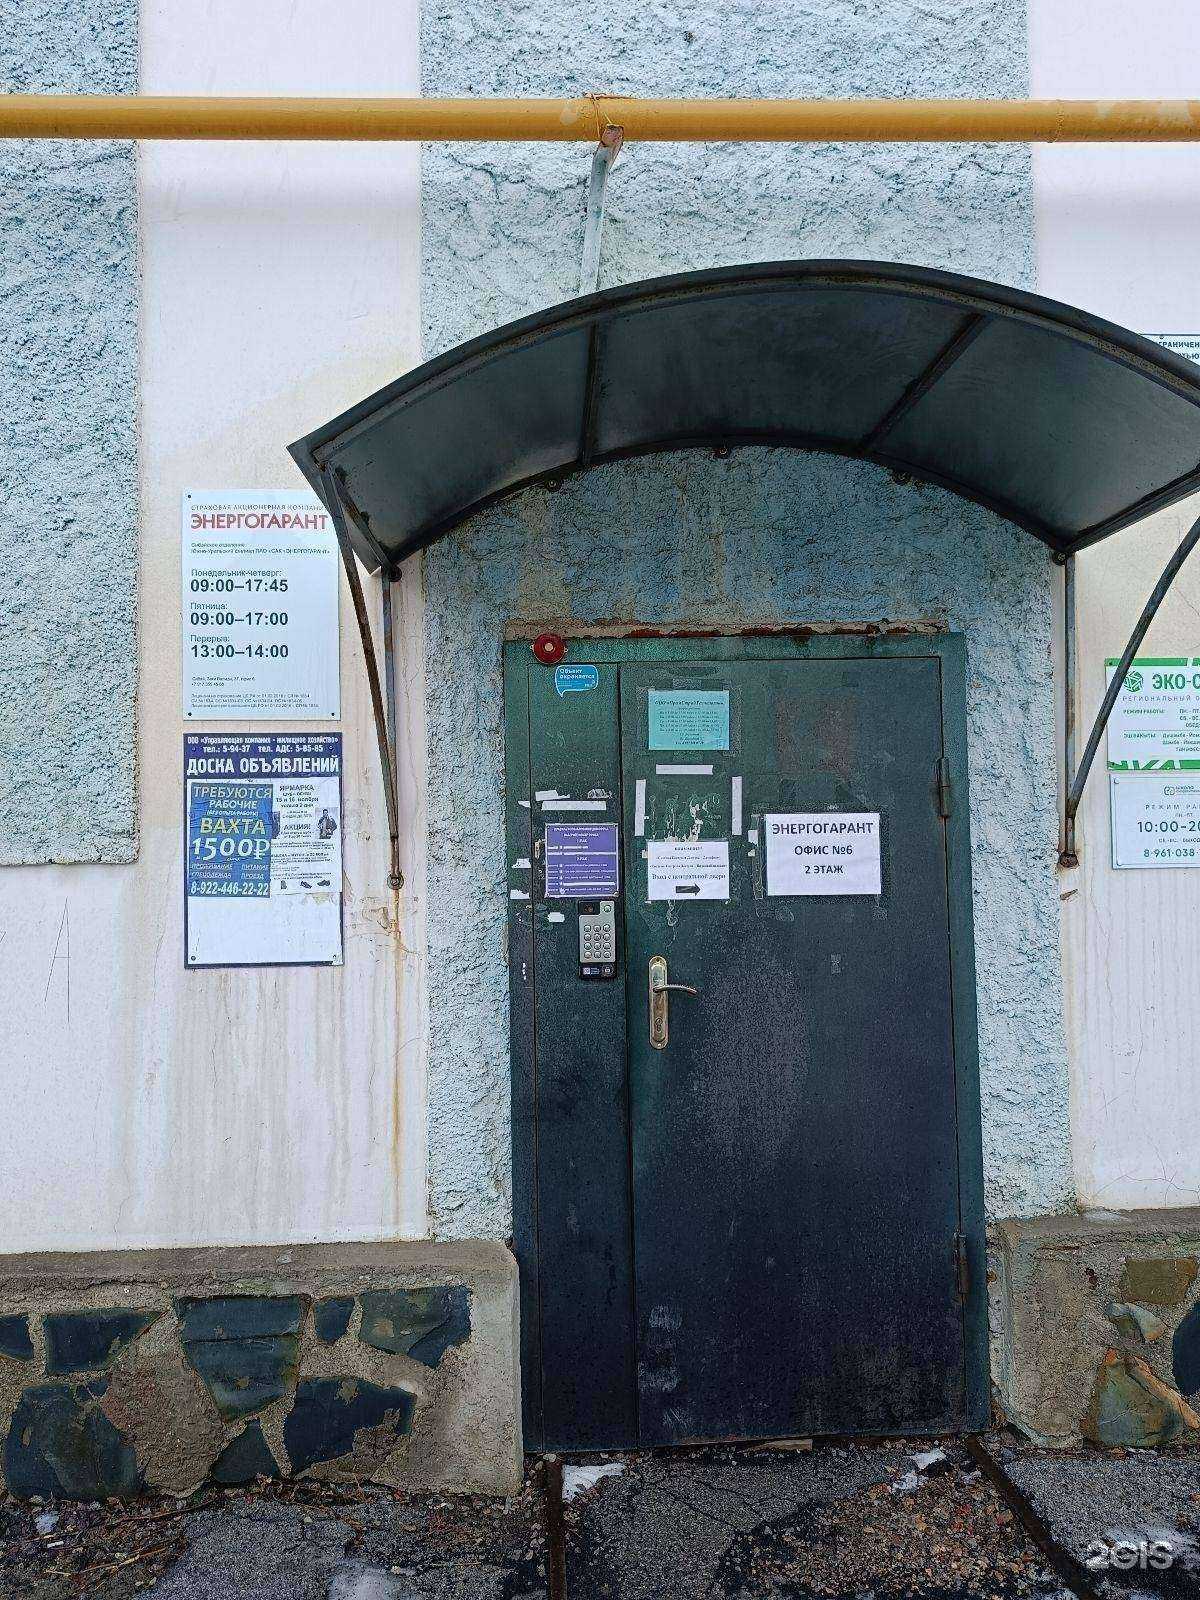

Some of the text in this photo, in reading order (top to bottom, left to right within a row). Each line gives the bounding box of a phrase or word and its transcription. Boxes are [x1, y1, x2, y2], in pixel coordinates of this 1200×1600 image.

[191, 513, 328, 530] ЭНЕРГОГАРАНТ
[191, 602, 228, 611] Пятница:
[191, 635, 230, 644] Перерыв:
[187, 736, 199, 744] ООО
[222, 745, 251, 753] 5-94-37
[258, 745, 273, 753] тел.
[275, 744, 293, 753] АДС:
[187, 754, 339, 776] ДОСКА ОБЪЯВЛЕНИЙ
[193, 786, 272, 799] ТРЕБУЮТСЯ
[209, 800, 258, 809] РАБОЧИЕ
[201, 817, 266, 835] ВАХТА
[771, 822, 874, 835] ЭНЕРГОГАРАНТ
[1137, 821, 1200, 833] 10:00-2
[794, 845, 853, 856] ОФИС №6
[805, 865, 844, 874] 2 ЭТАЖ
[191, 881, 269, 896] 8-922-446-22-22
